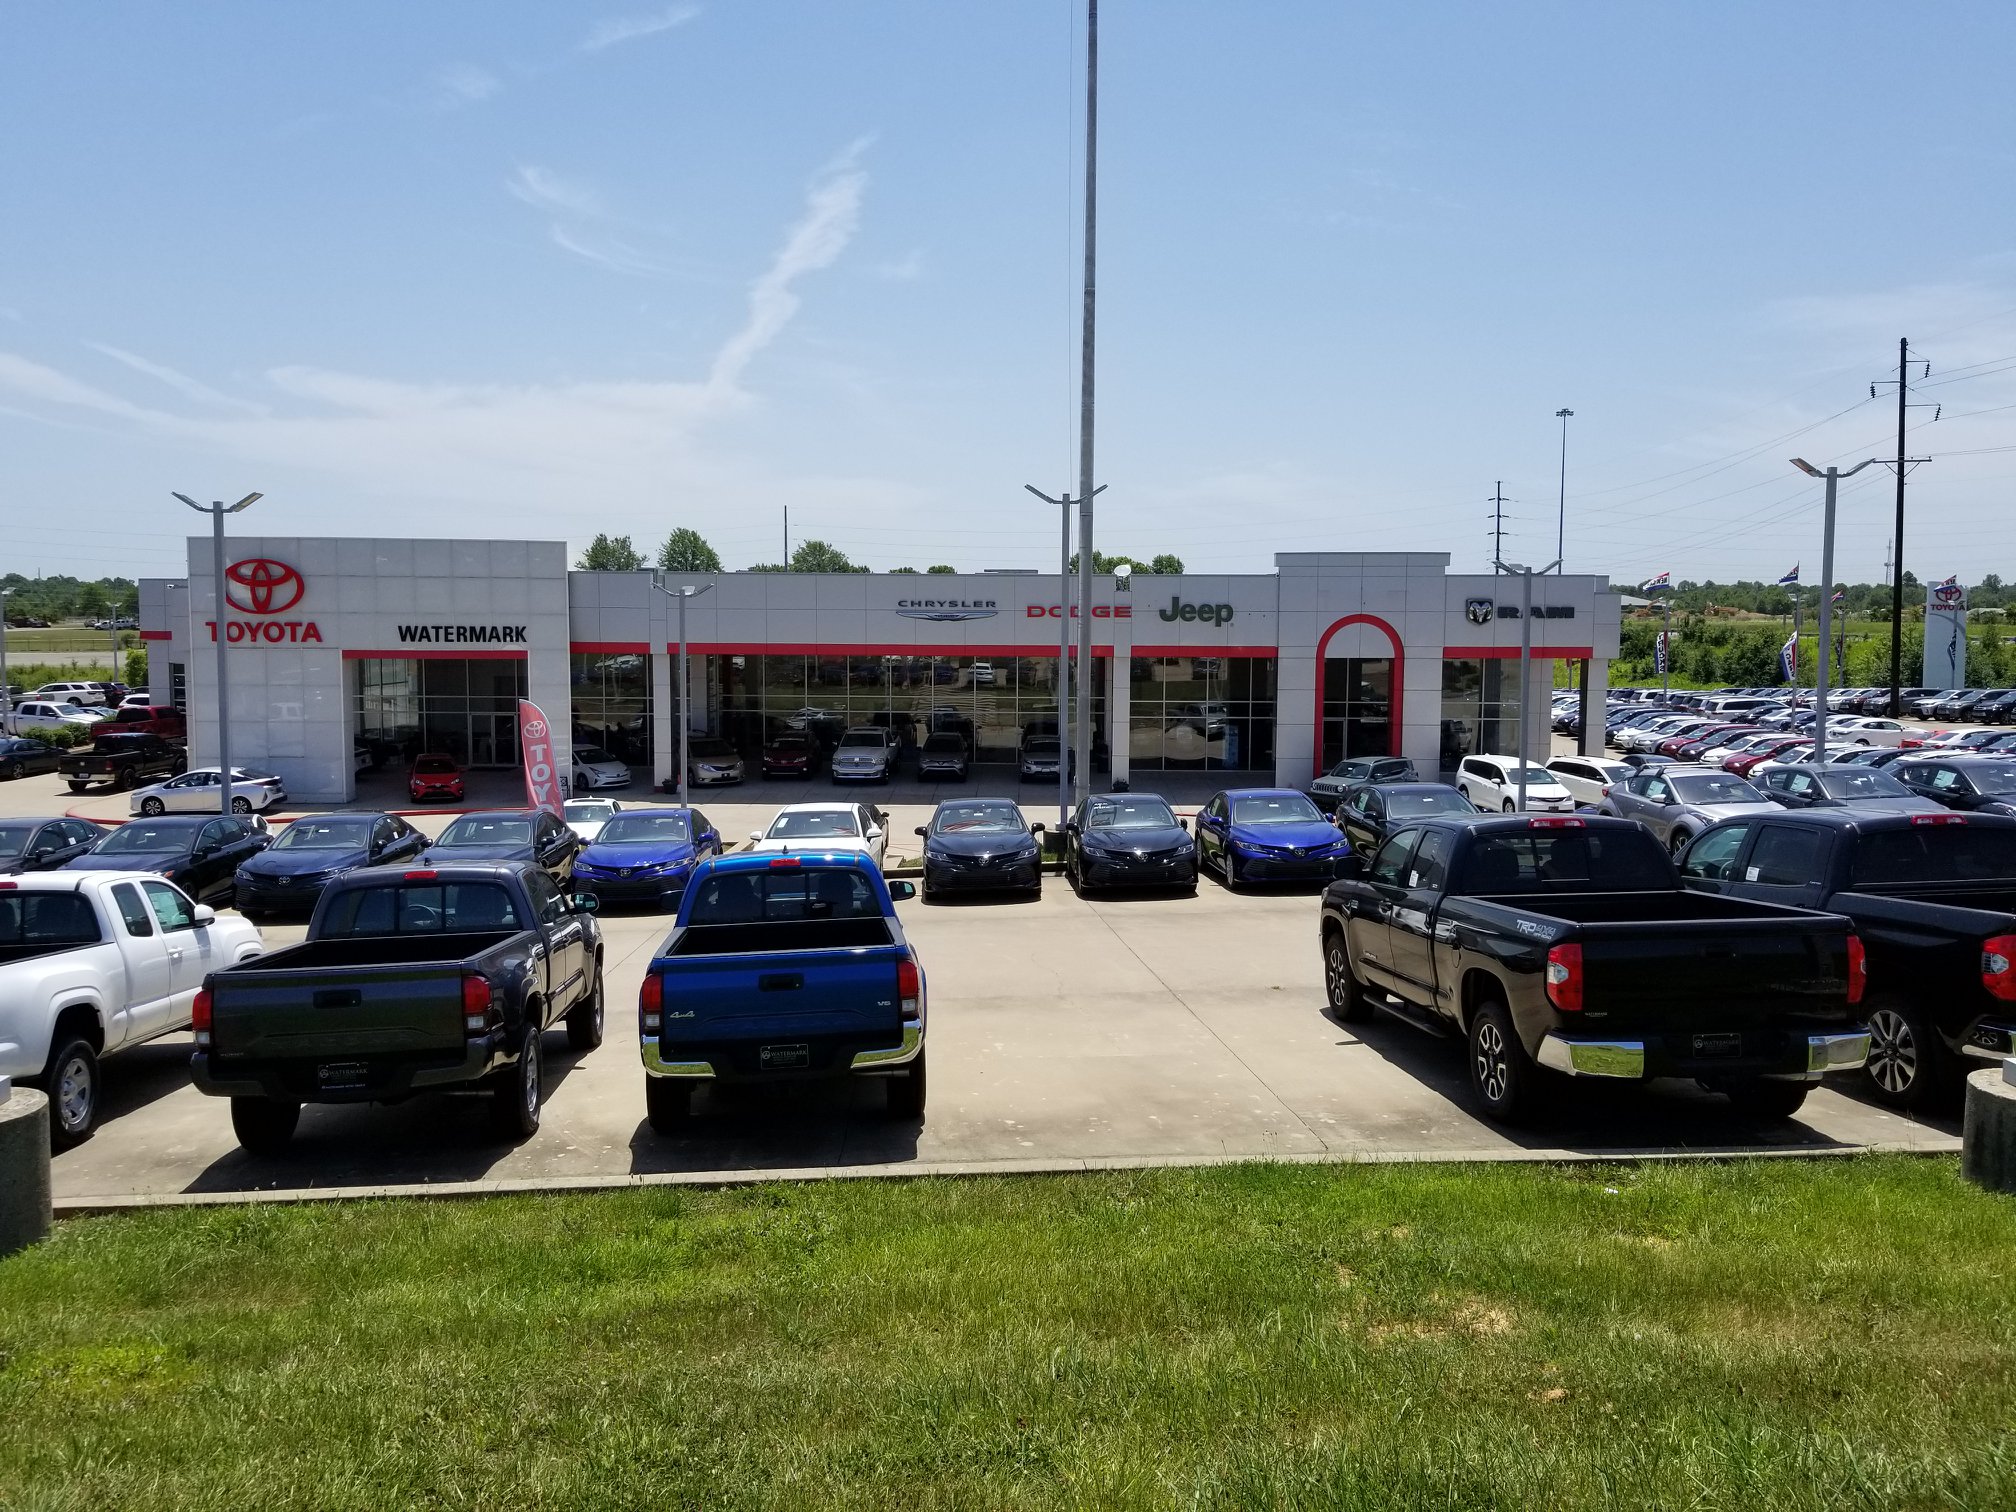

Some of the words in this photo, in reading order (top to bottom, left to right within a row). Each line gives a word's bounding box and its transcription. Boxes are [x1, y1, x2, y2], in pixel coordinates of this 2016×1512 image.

[897, 600, 997, 608] CHRYSLER
[1158, 596, 1234, 627] Jeep
[1930, 603, 1966, 611] TOYOA
[1497, 606, 1575, 619] RAM
[205, 621, 323, 643] TOYOTA
[397, 625, 527, 643] WATERMARK
[1516, 919, 1537, 934] TRD
